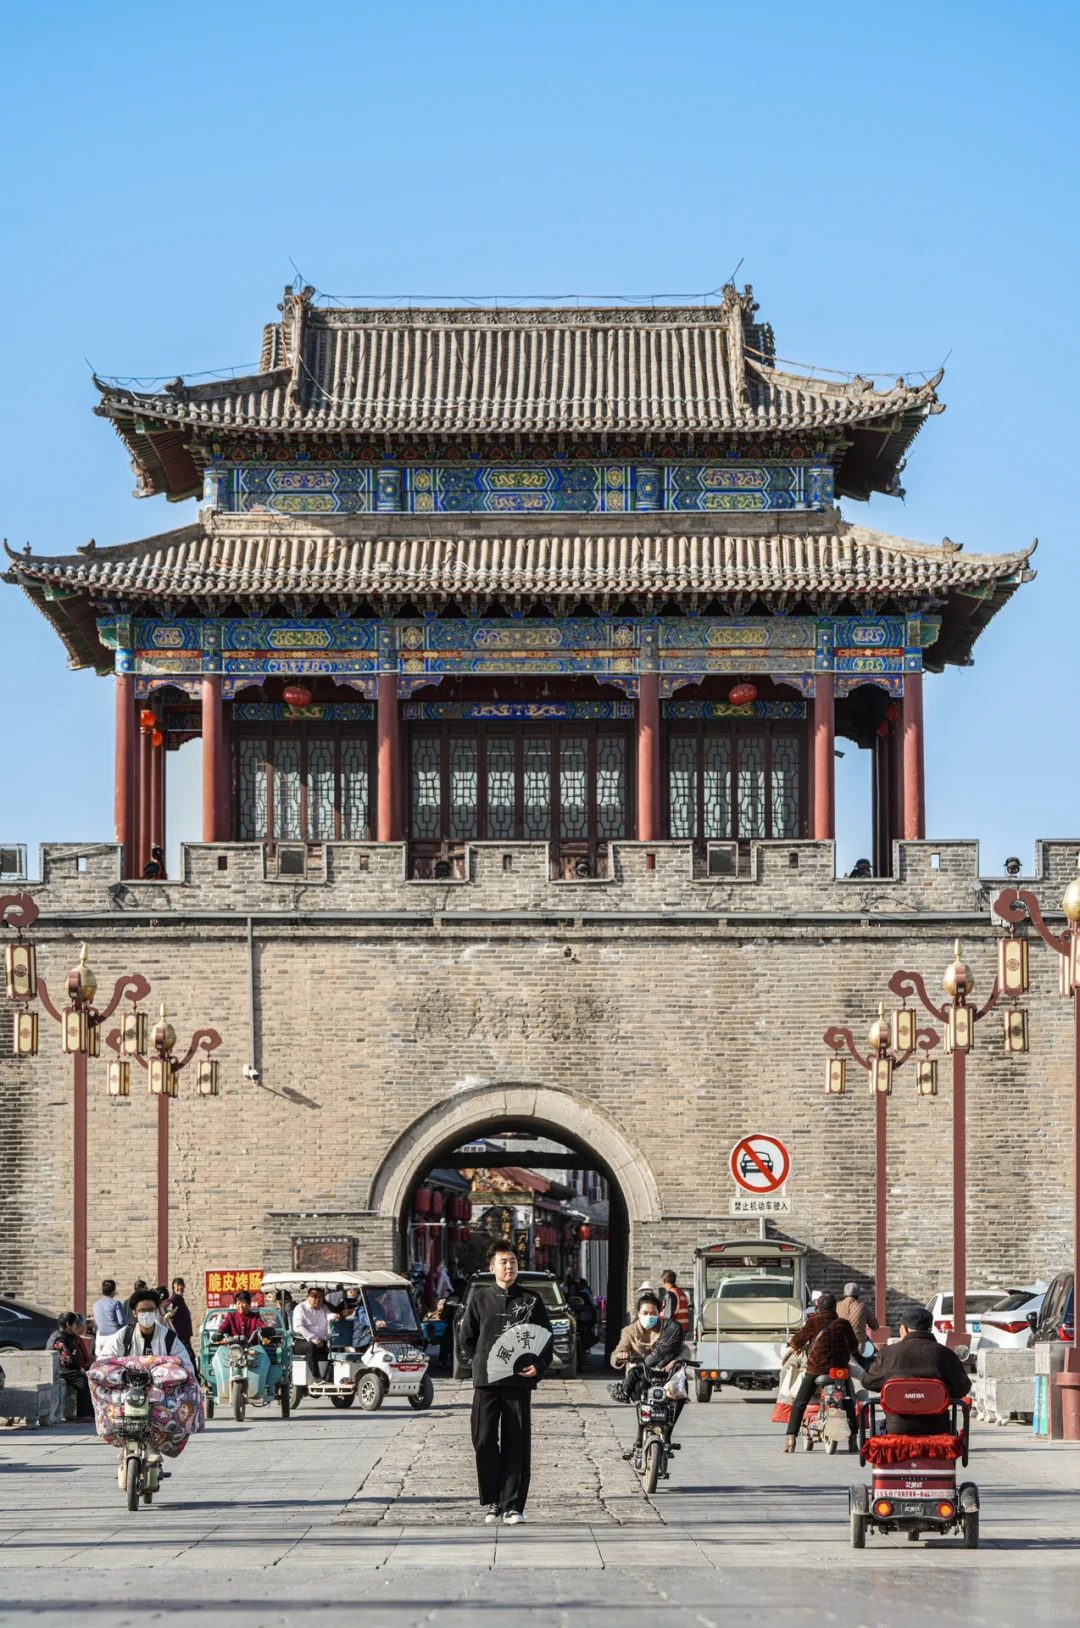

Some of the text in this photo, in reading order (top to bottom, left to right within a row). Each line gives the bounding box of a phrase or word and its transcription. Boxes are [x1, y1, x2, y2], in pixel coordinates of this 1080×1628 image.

[734, 1200, 788, 1211] 禁止机动车驶入
[208, 1272, 262, 1292] 脆皮烤肠
